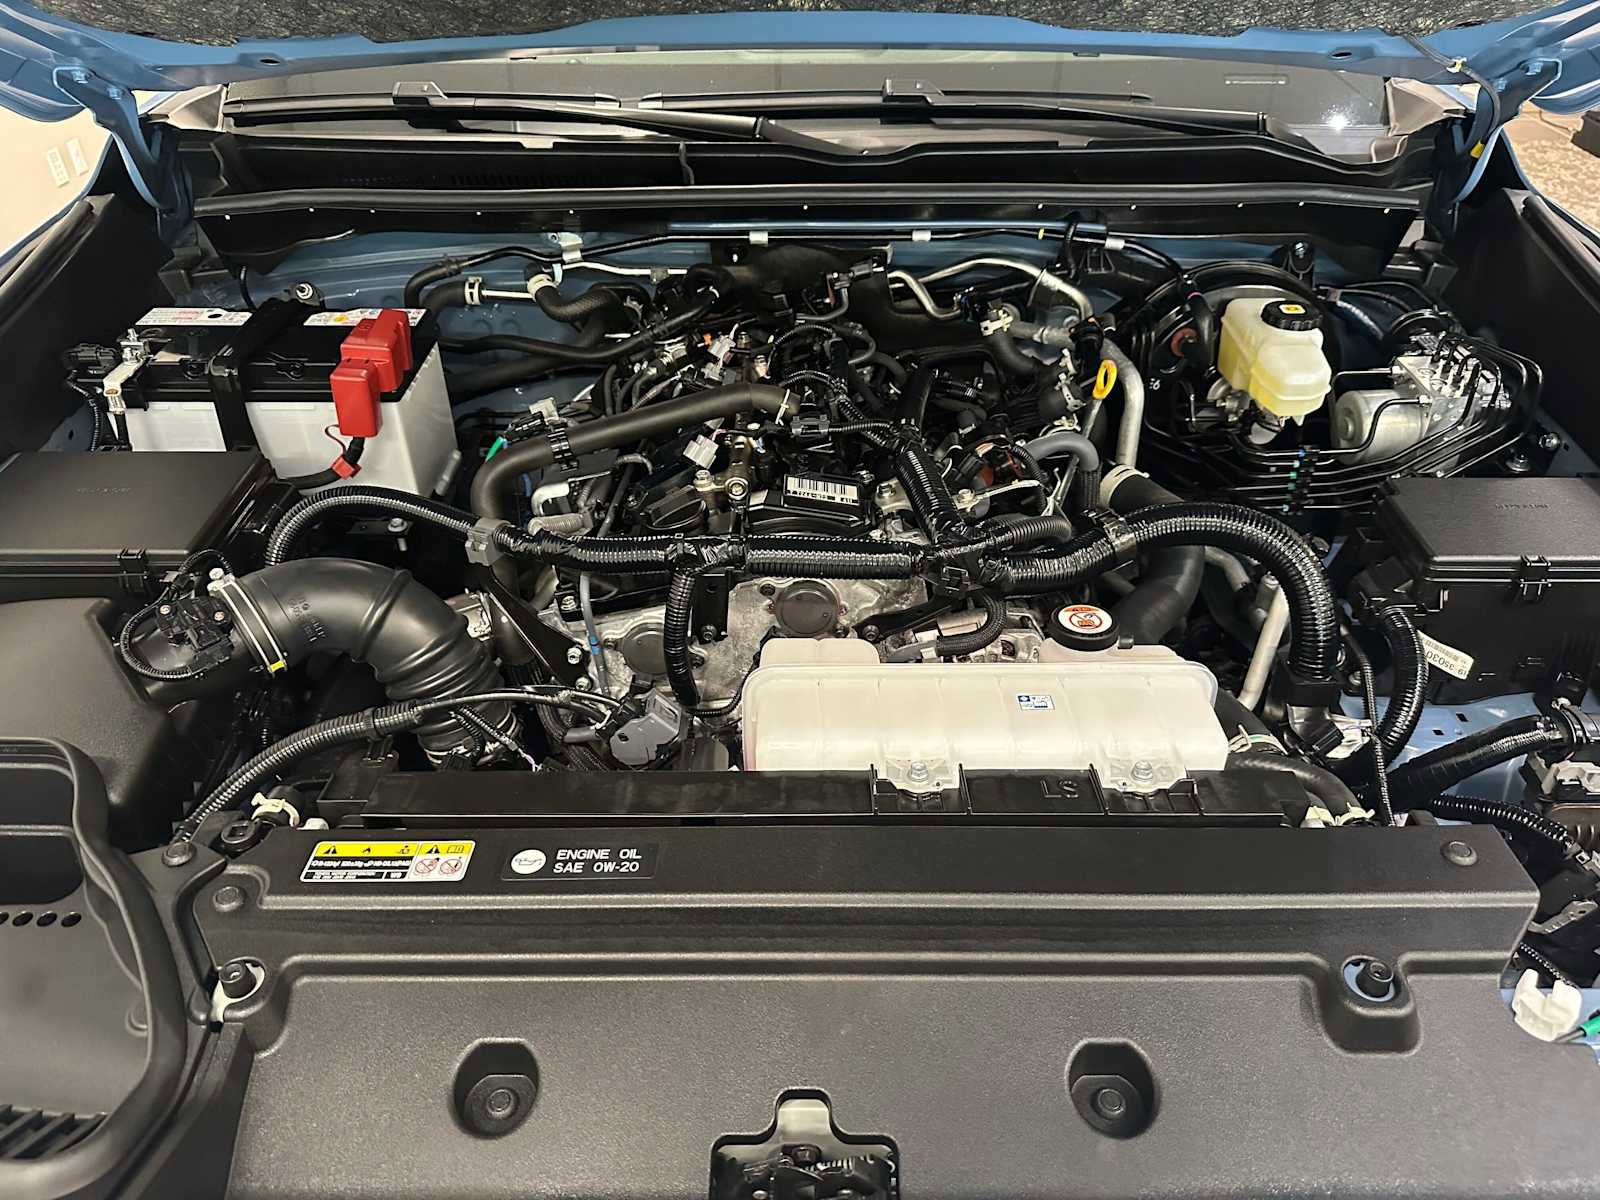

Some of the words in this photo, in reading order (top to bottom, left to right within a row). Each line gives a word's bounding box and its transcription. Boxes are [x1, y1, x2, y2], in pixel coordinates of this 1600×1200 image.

[1040, 779, 1079, 799] LS
[556, 848, 611, 860] ENGINE
[618, 848, 642, 859] OIL
[553, 862, 585, 873] SAE
[593, 861, 640, 873] 0W-20
